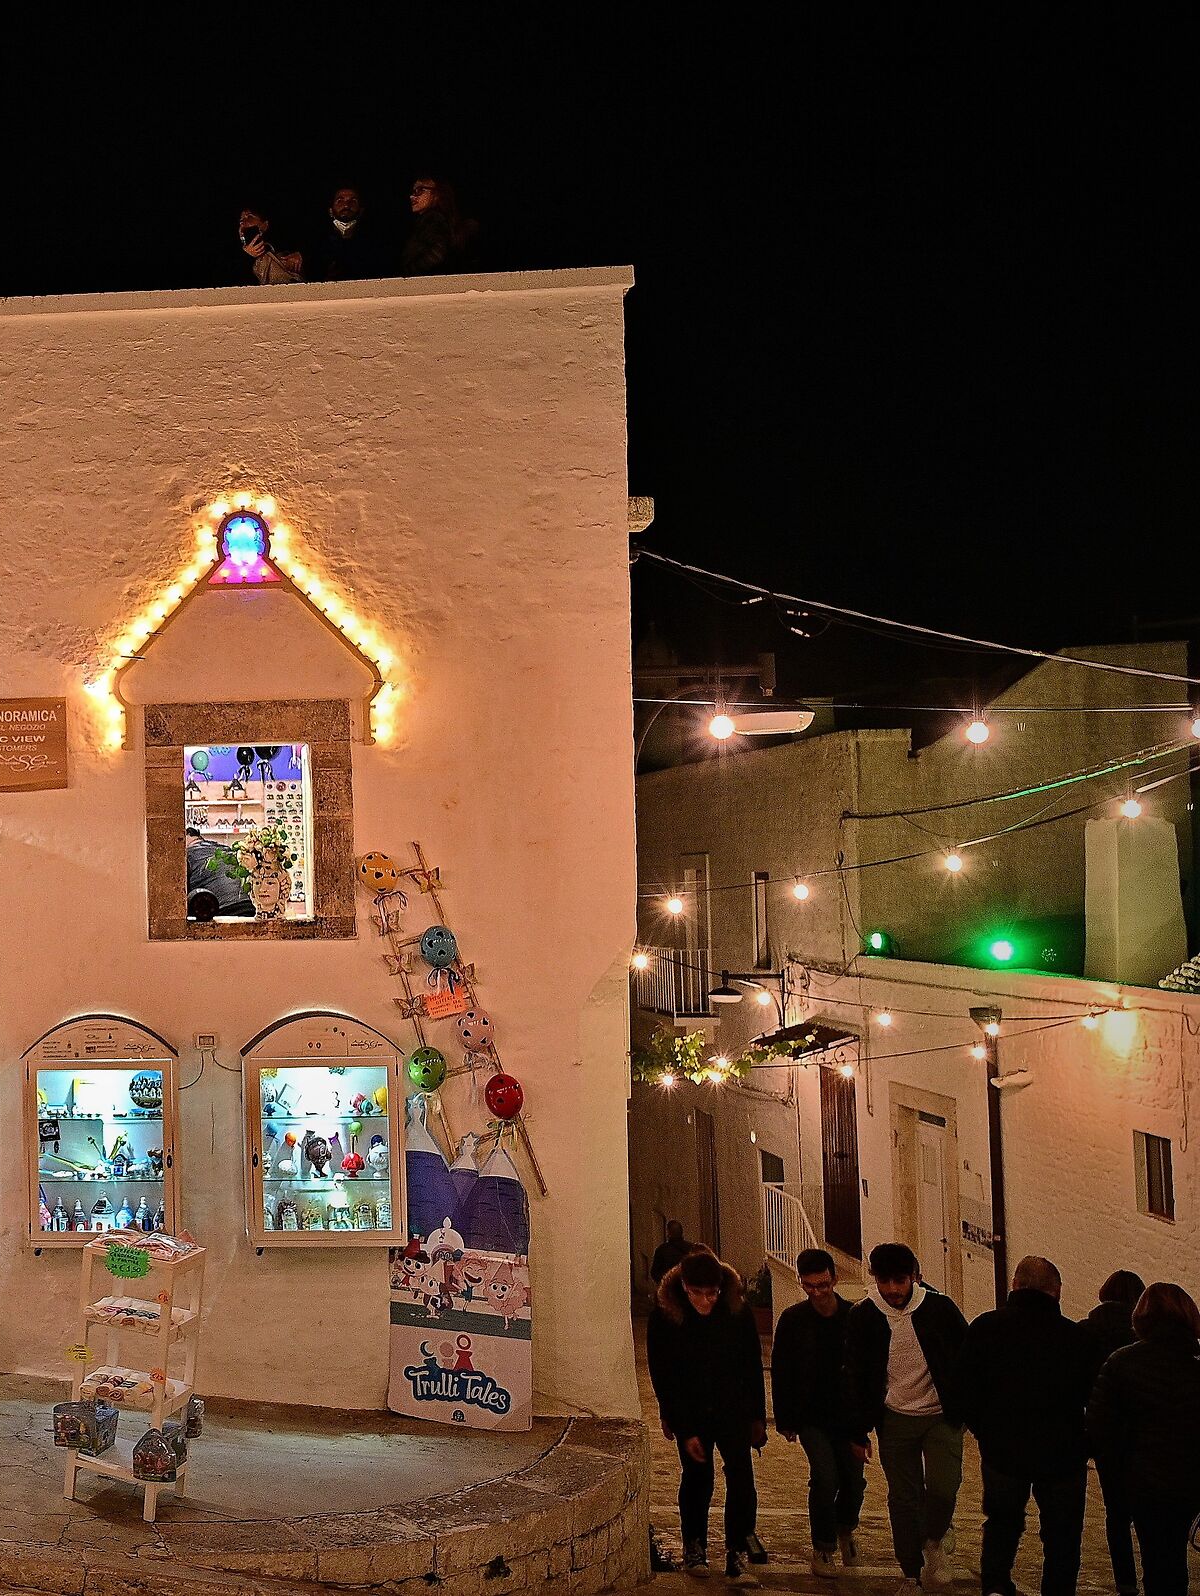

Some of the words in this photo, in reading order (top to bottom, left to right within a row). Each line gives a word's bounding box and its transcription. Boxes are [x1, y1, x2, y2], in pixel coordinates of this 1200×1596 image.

[9, 723, 46, 732] NEGOZIO
[12, 735, 47, 743] VIEW
[408, 1370, 460, 1398] Trulli
[460, 1372, 507, 1410] Tales
